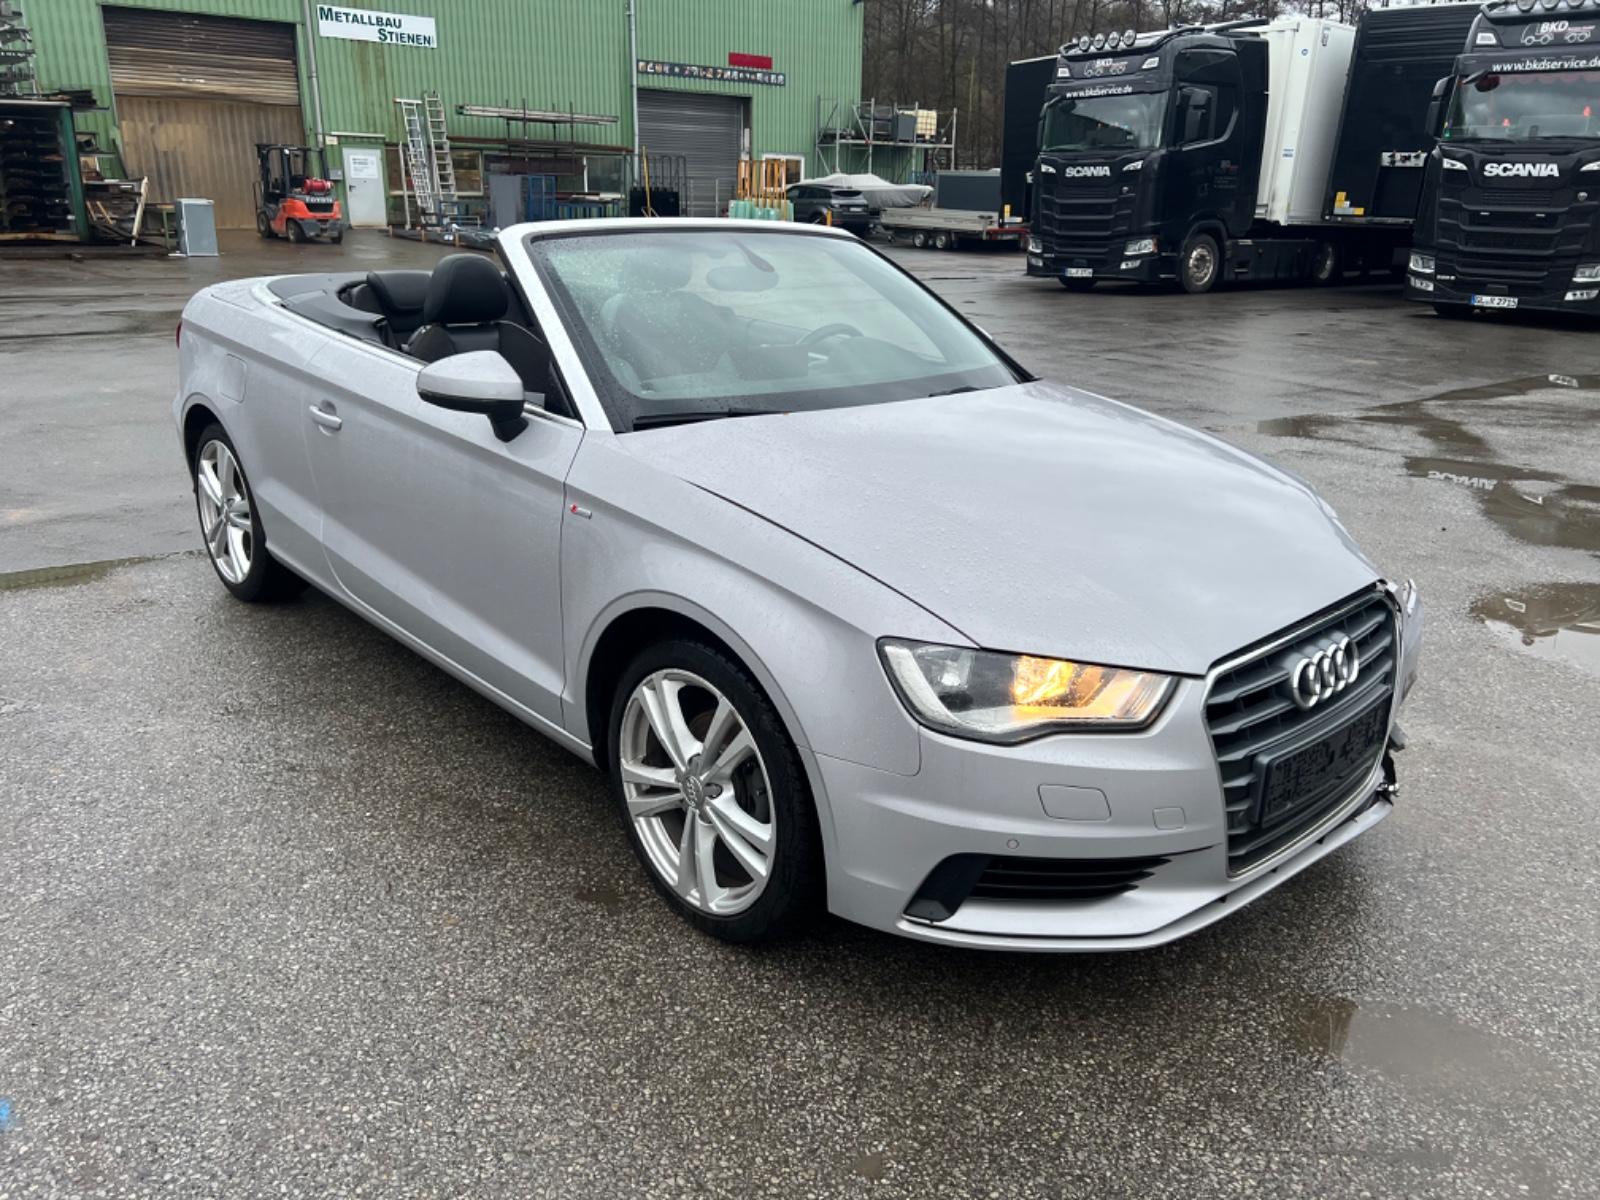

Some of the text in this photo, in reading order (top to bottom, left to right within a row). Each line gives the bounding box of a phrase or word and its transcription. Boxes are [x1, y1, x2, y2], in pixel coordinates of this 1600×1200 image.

[319, 6, 402, 29] METALLBAU
[1540, 20, 1569, 33] BKD
[377, 28, 431, 45] STIENEN
[1065, 166, 1111, 177] SCANIA
[1483, 163, 1560, 177] SCANIA
